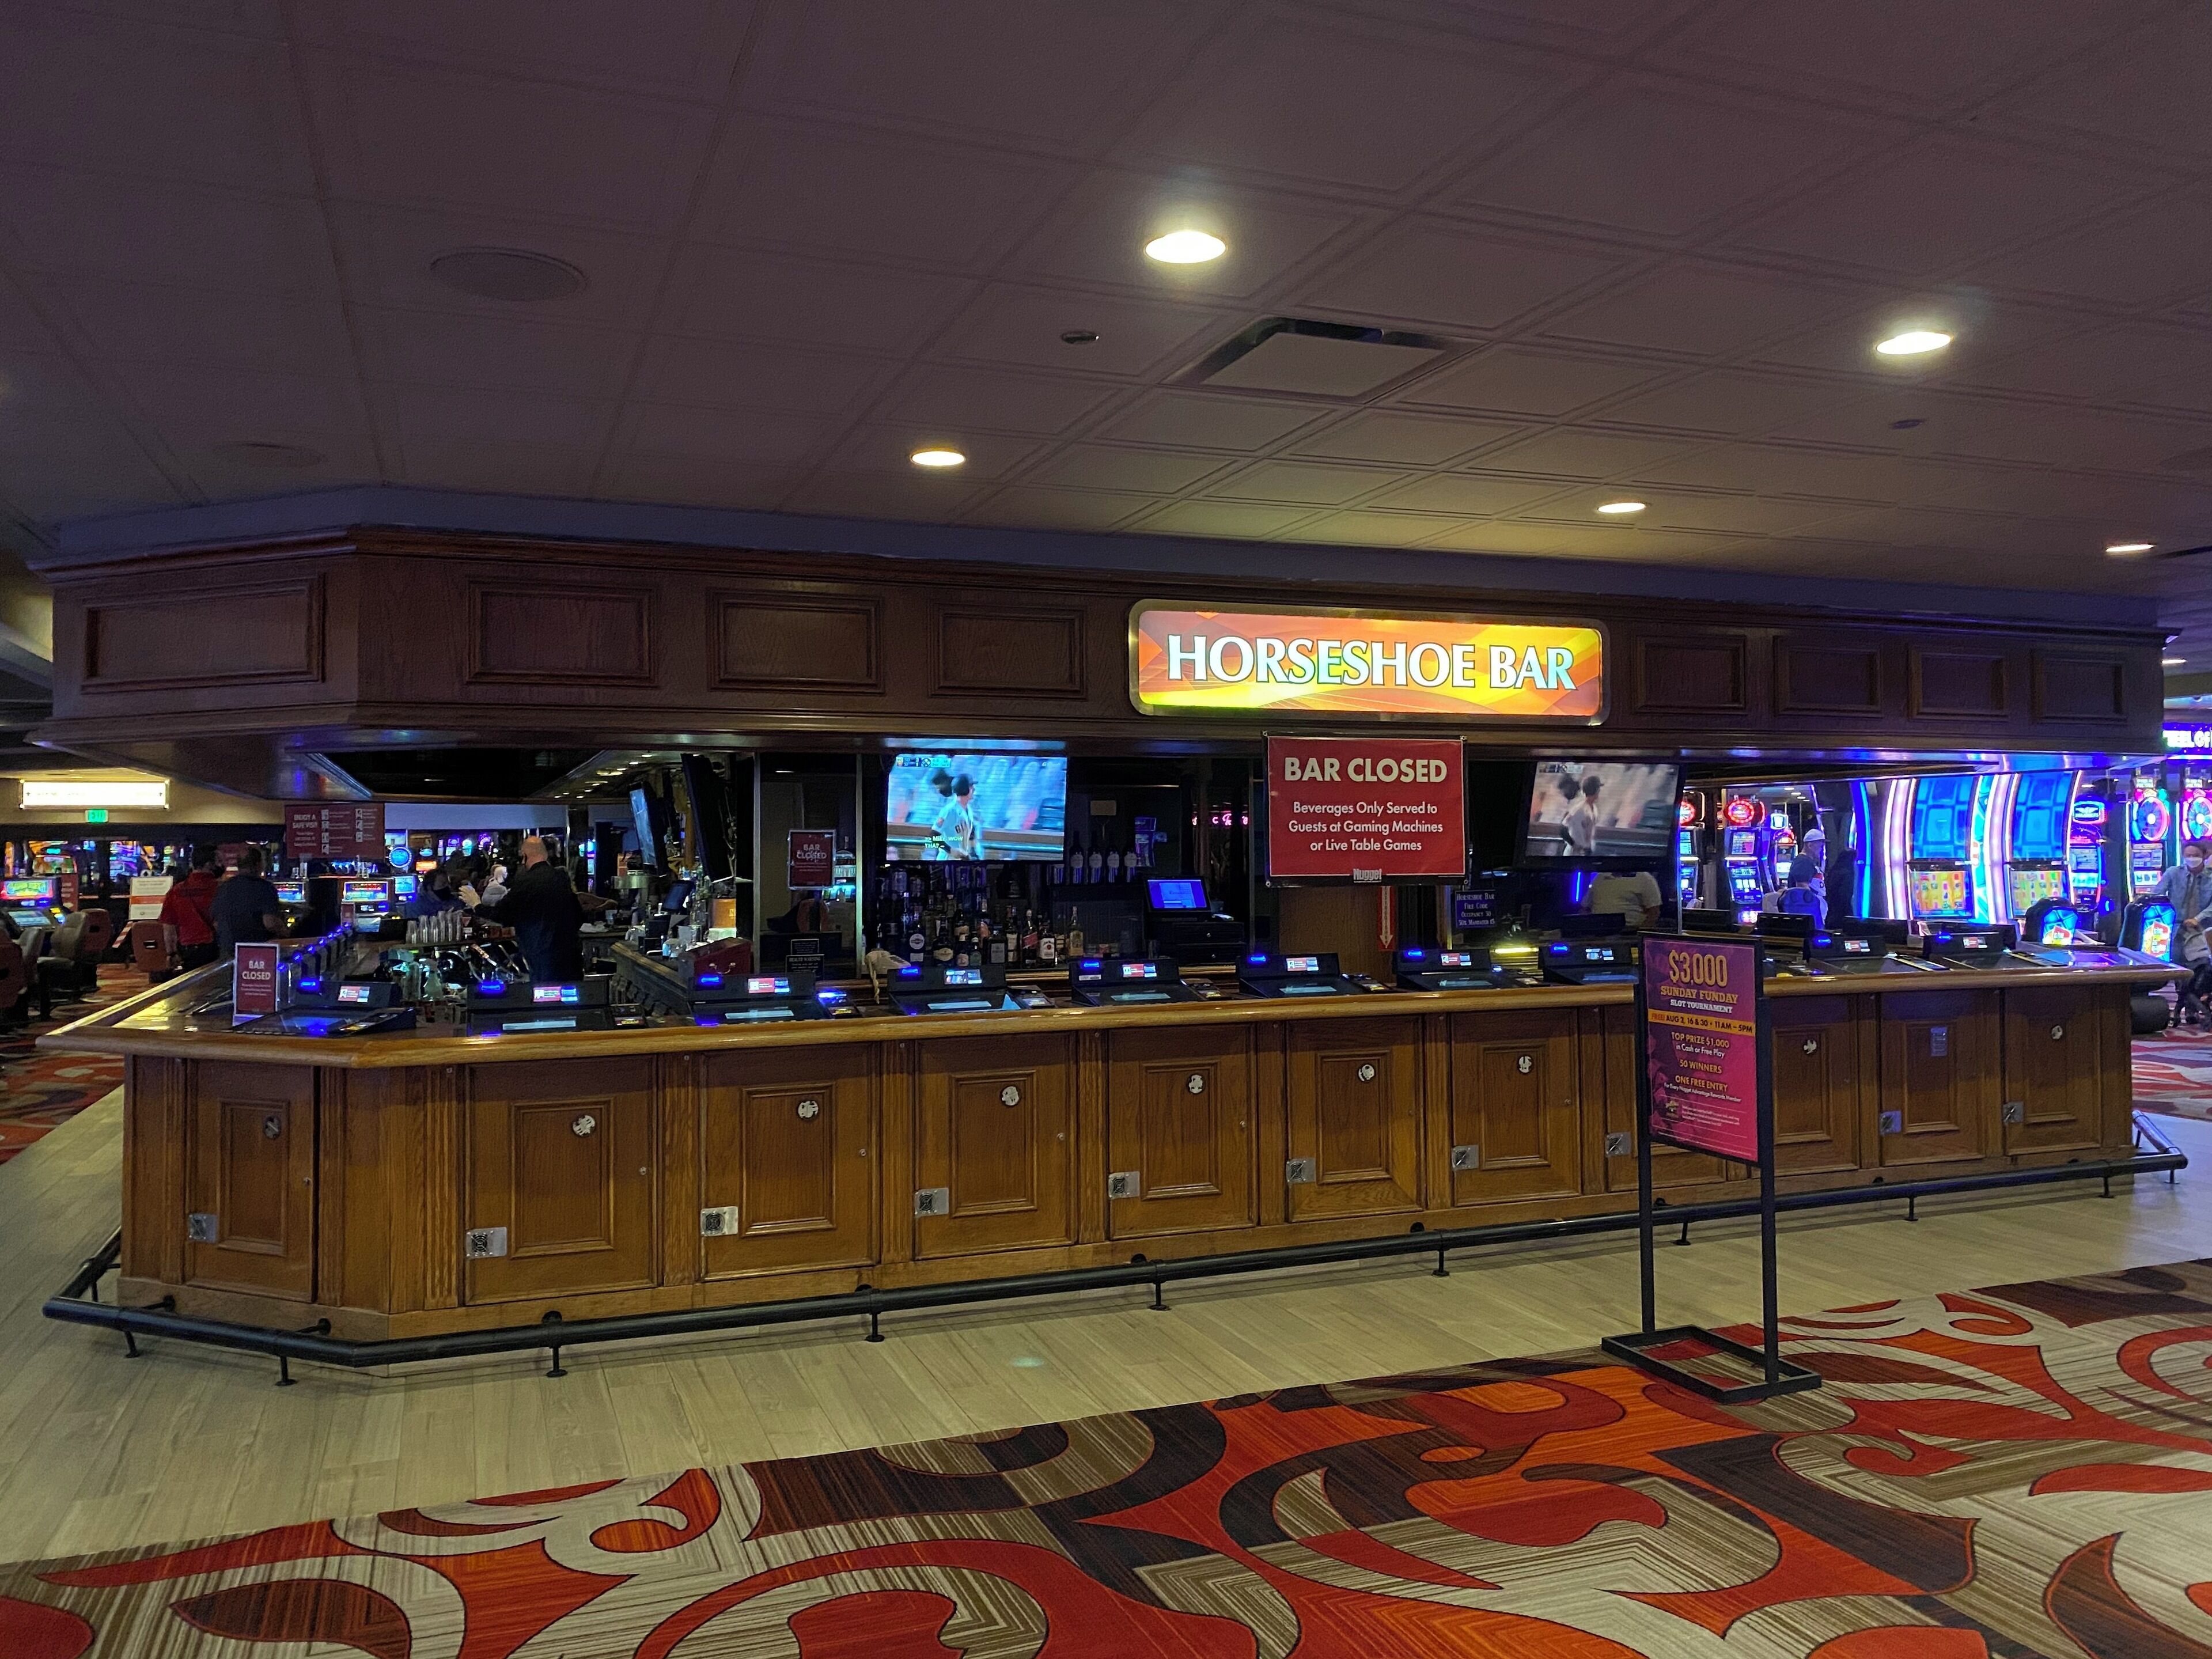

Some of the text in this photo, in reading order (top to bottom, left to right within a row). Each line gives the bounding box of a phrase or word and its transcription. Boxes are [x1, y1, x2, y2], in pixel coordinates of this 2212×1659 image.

[1168, 634, 1578, 691] HORSESHOE BAR
[1284, 757, 1448, 783] BAR CLOSED
[1293, 801, 1438, 817] Beverages Only Served to
[1289, 820, 1443, 836] Guests at Gaming Machines
[1310, 839, 1422, 851] or Live Table Games
[1353, 868, 1382, 881] Nugget
[248, 960, 265, 969] BAR
[1669, 949, 1728, 987] $3,000
[242, 971, 271, 980] CLOSED
[1660, 986, 1738, 1004] SUNDAY FUNDAY
[1687, 1001, 1733, 1013] TOURNAMENT
[1666, 1015, 1679, 1023] AUG
[1738, 1024, 1752, 1033] 5PM
[1672, 1032, 1729, 1048] TOP PRIZE $1,000
[1681, 1043, 1694, 1053] Cash
[1701, 1047, 1713, 1056] Free
[1713, 1048, 1725, 1059] Play
[1680, 1059, 1722, 1074] 50 WINNERS
[1675, 1075, 1728, 1092] ONE FREE ENTRY
